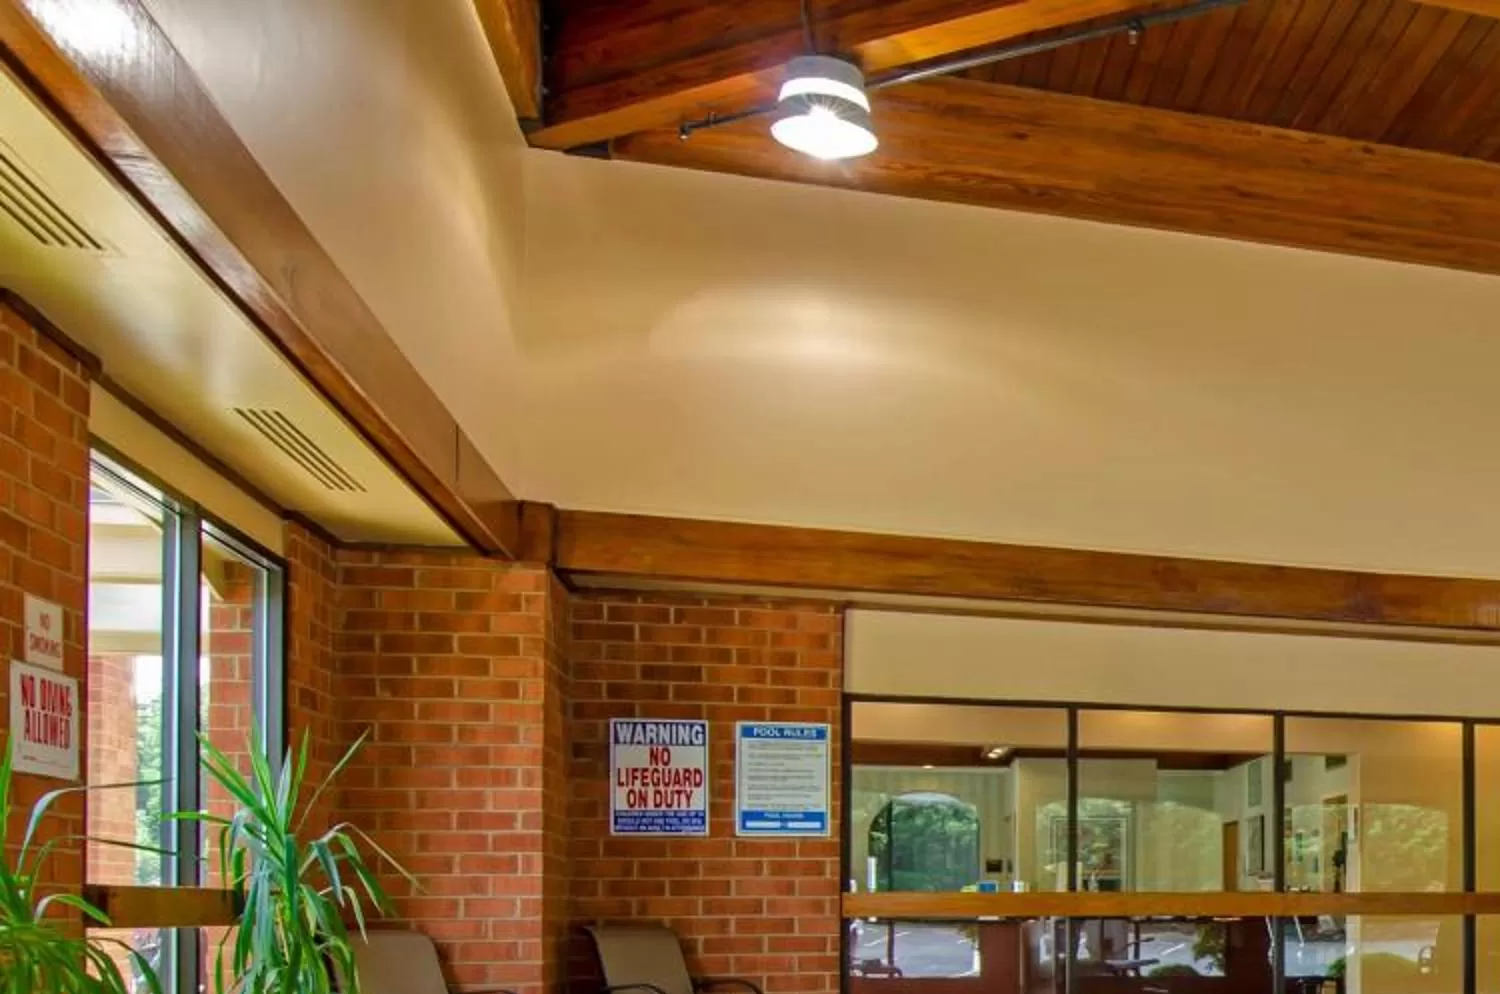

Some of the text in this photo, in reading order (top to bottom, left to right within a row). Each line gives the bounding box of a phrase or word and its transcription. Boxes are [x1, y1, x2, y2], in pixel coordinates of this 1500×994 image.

[21, 673, 36, 708] NO
[40, 678, 72, 717] DIVING
[24, 708, 70, 750] ALLOWED
[616, 723, 704, 745] WARNING
[649, 747, 671, 767] NO
[617, 767, 703, 788] LIFEGUARD
[627, 789, 693, 808] ON DUTY
